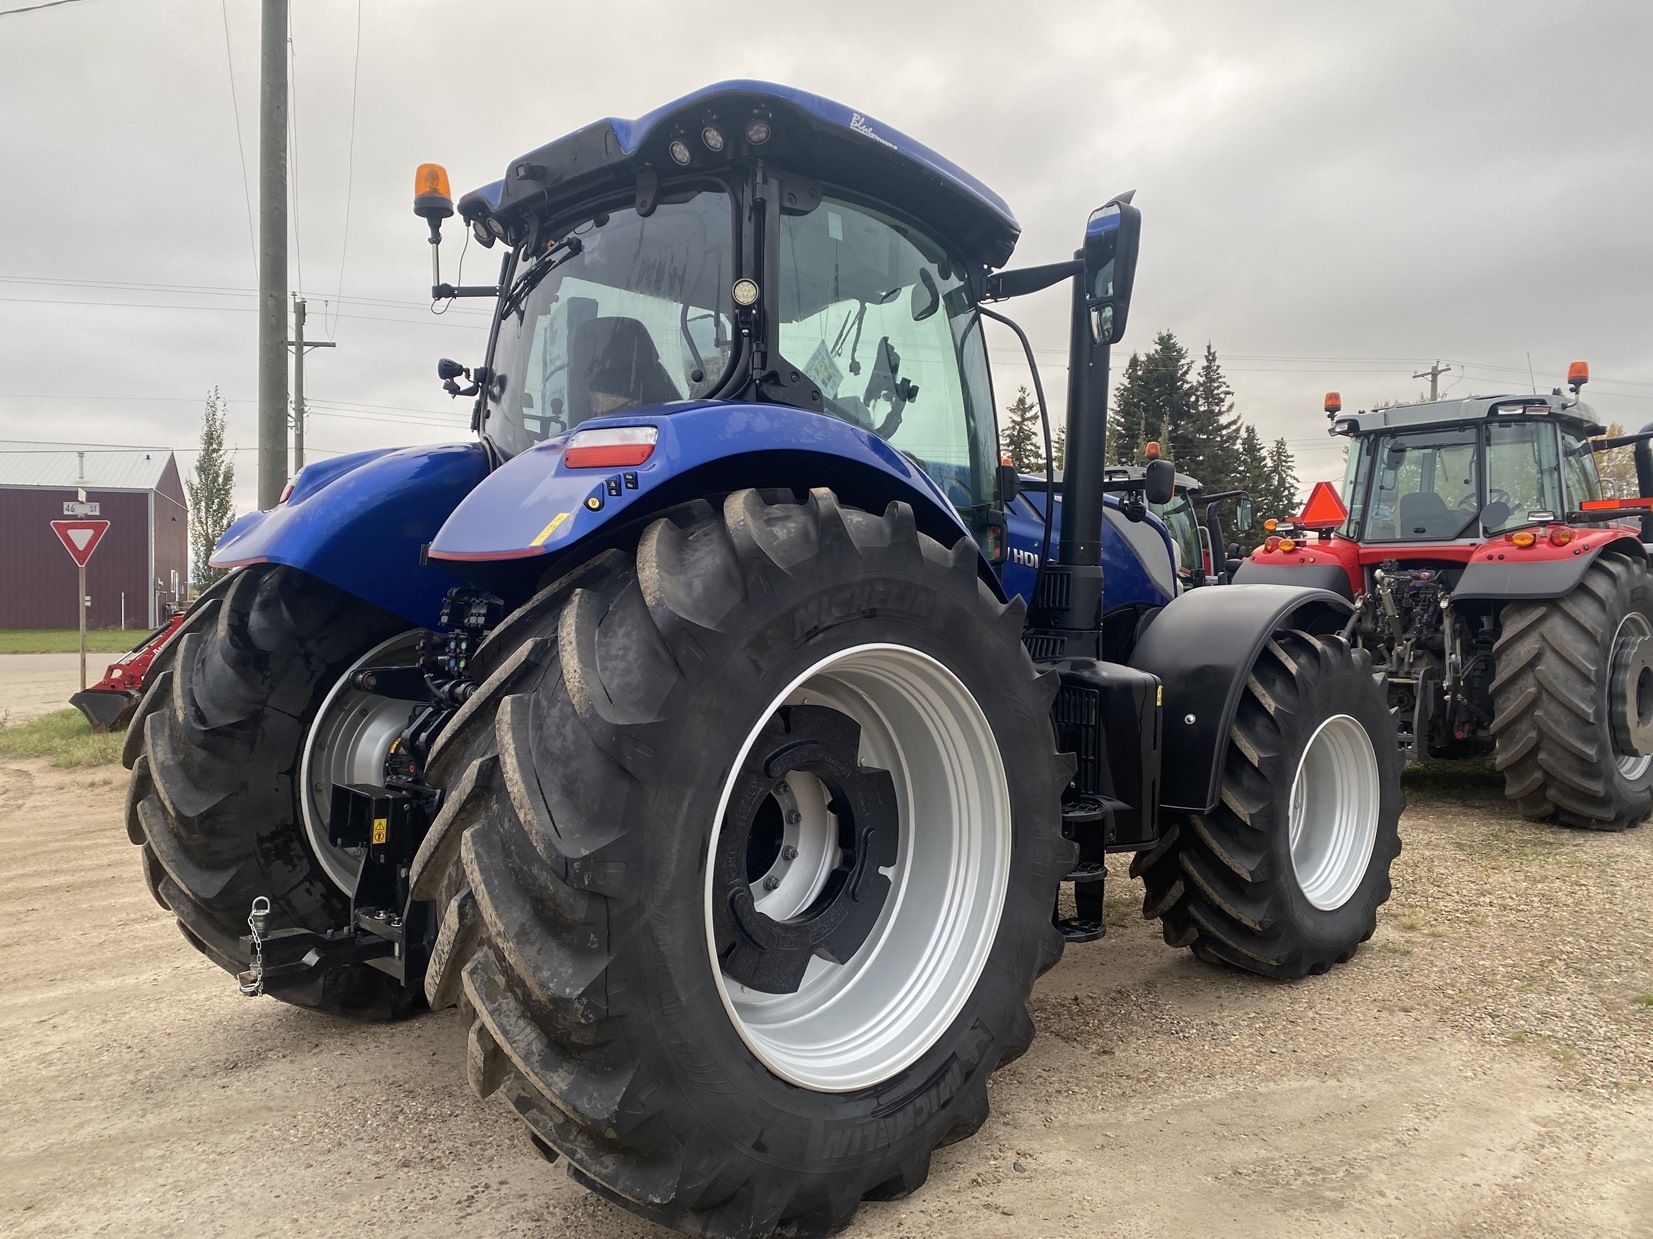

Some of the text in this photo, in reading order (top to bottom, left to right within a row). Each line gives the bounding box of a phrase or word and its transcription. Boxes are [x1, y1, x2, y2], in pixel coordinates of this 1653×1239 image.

[65, 503, 97, 513] 46 ST
[794, 580, 936, 640] MICHELIN
[821, 1059, 962, 1161] MICHELIN
